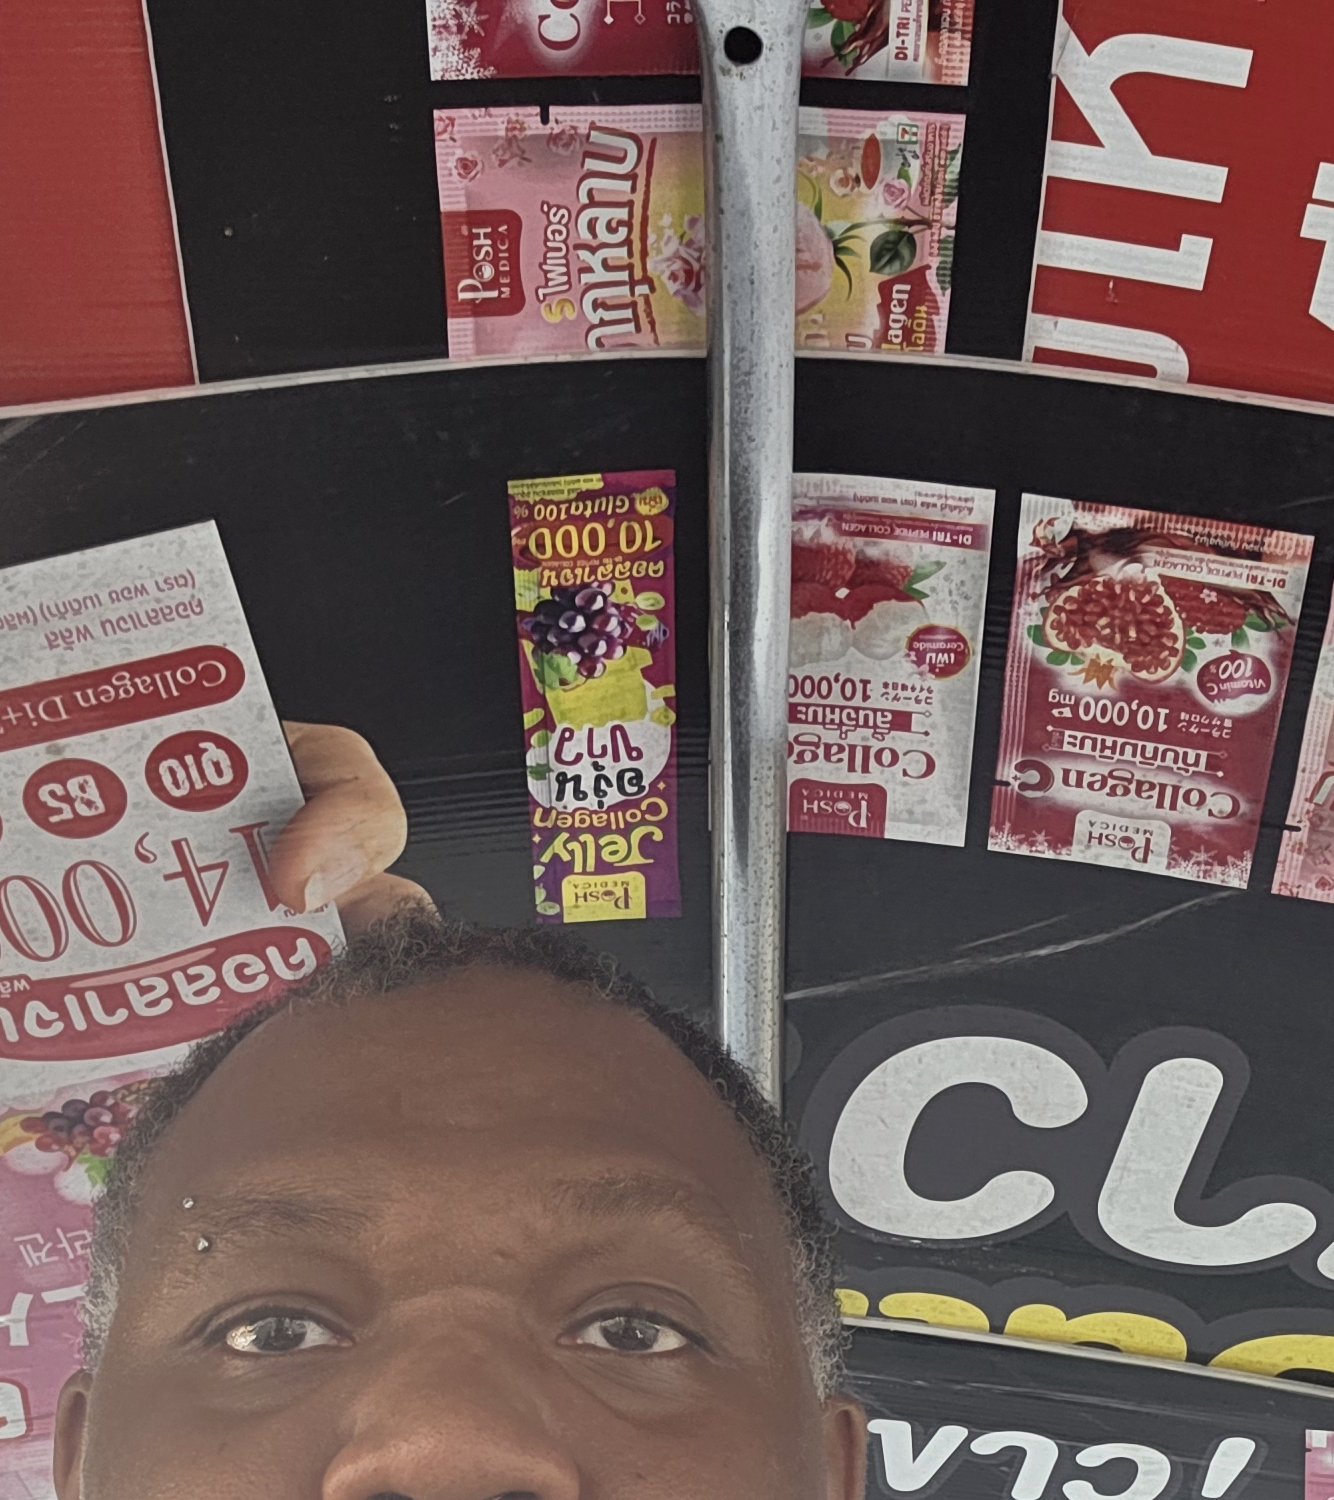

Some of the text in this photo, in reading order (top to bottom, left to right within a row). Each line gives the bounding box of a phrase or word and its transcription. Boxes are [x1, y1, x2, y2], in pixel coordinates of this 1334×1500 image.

[894, 16, 911, 61] DI-TRI
[536, 201, 572, 303] ไฟเบอร์
[575, 128, 649, 351] ากุหลาบ
[498, 223, 512, 298] MEDICA
[881, 283, 912, 350] lagen
[527, 517, 661, 558] 10,000
[840, 521, 891, 534] COLLAGEN
[892, 526, 929, 538] PEPTIDE
[931, 529, 971, 545] DI-TRI
[152, 568, 196, 593] (ตรา
[541, 559, 663, 586] คอลลาเจน
[1152, 558, 1203, 574] COLLAGEN
[1245, 571, 1286, 588] DI-TRI
[41, 596, 205, 652] คอลลาเจน พลัส
[911, 637, 964, 652] Ceramide
[72, 656, 227, 707] Collagen
[924, 650, 954, 672] เพิ่ม
[1217, 655, 1253, 680] 100
[1204, 676, 1266, 694] Vitamin C
[1046, 687, 1169, 731] 10,000 mg
[553, 722, 642, 765] ขาว
[789, 731, 935, 779] Collag
[1065, 732, 1202, 774] ทับทิมหิมะ
[156, 740, 233, 796] Q10
[554, 760, 642, 809] องุ่น
[35, 773, 104, 822] B5
[531, 795, 668, 829] Collagen
[800, 787, 867, 799] MEDICA
[1059, 766, 1241, 820] Collagen
[1087, 818, 1153, 835] MEDICA
[539, 824, 662, 872] Jelly
[571, 878, 629, 889] MEDICA
[15, 1226, 89, 1267] 라겐
